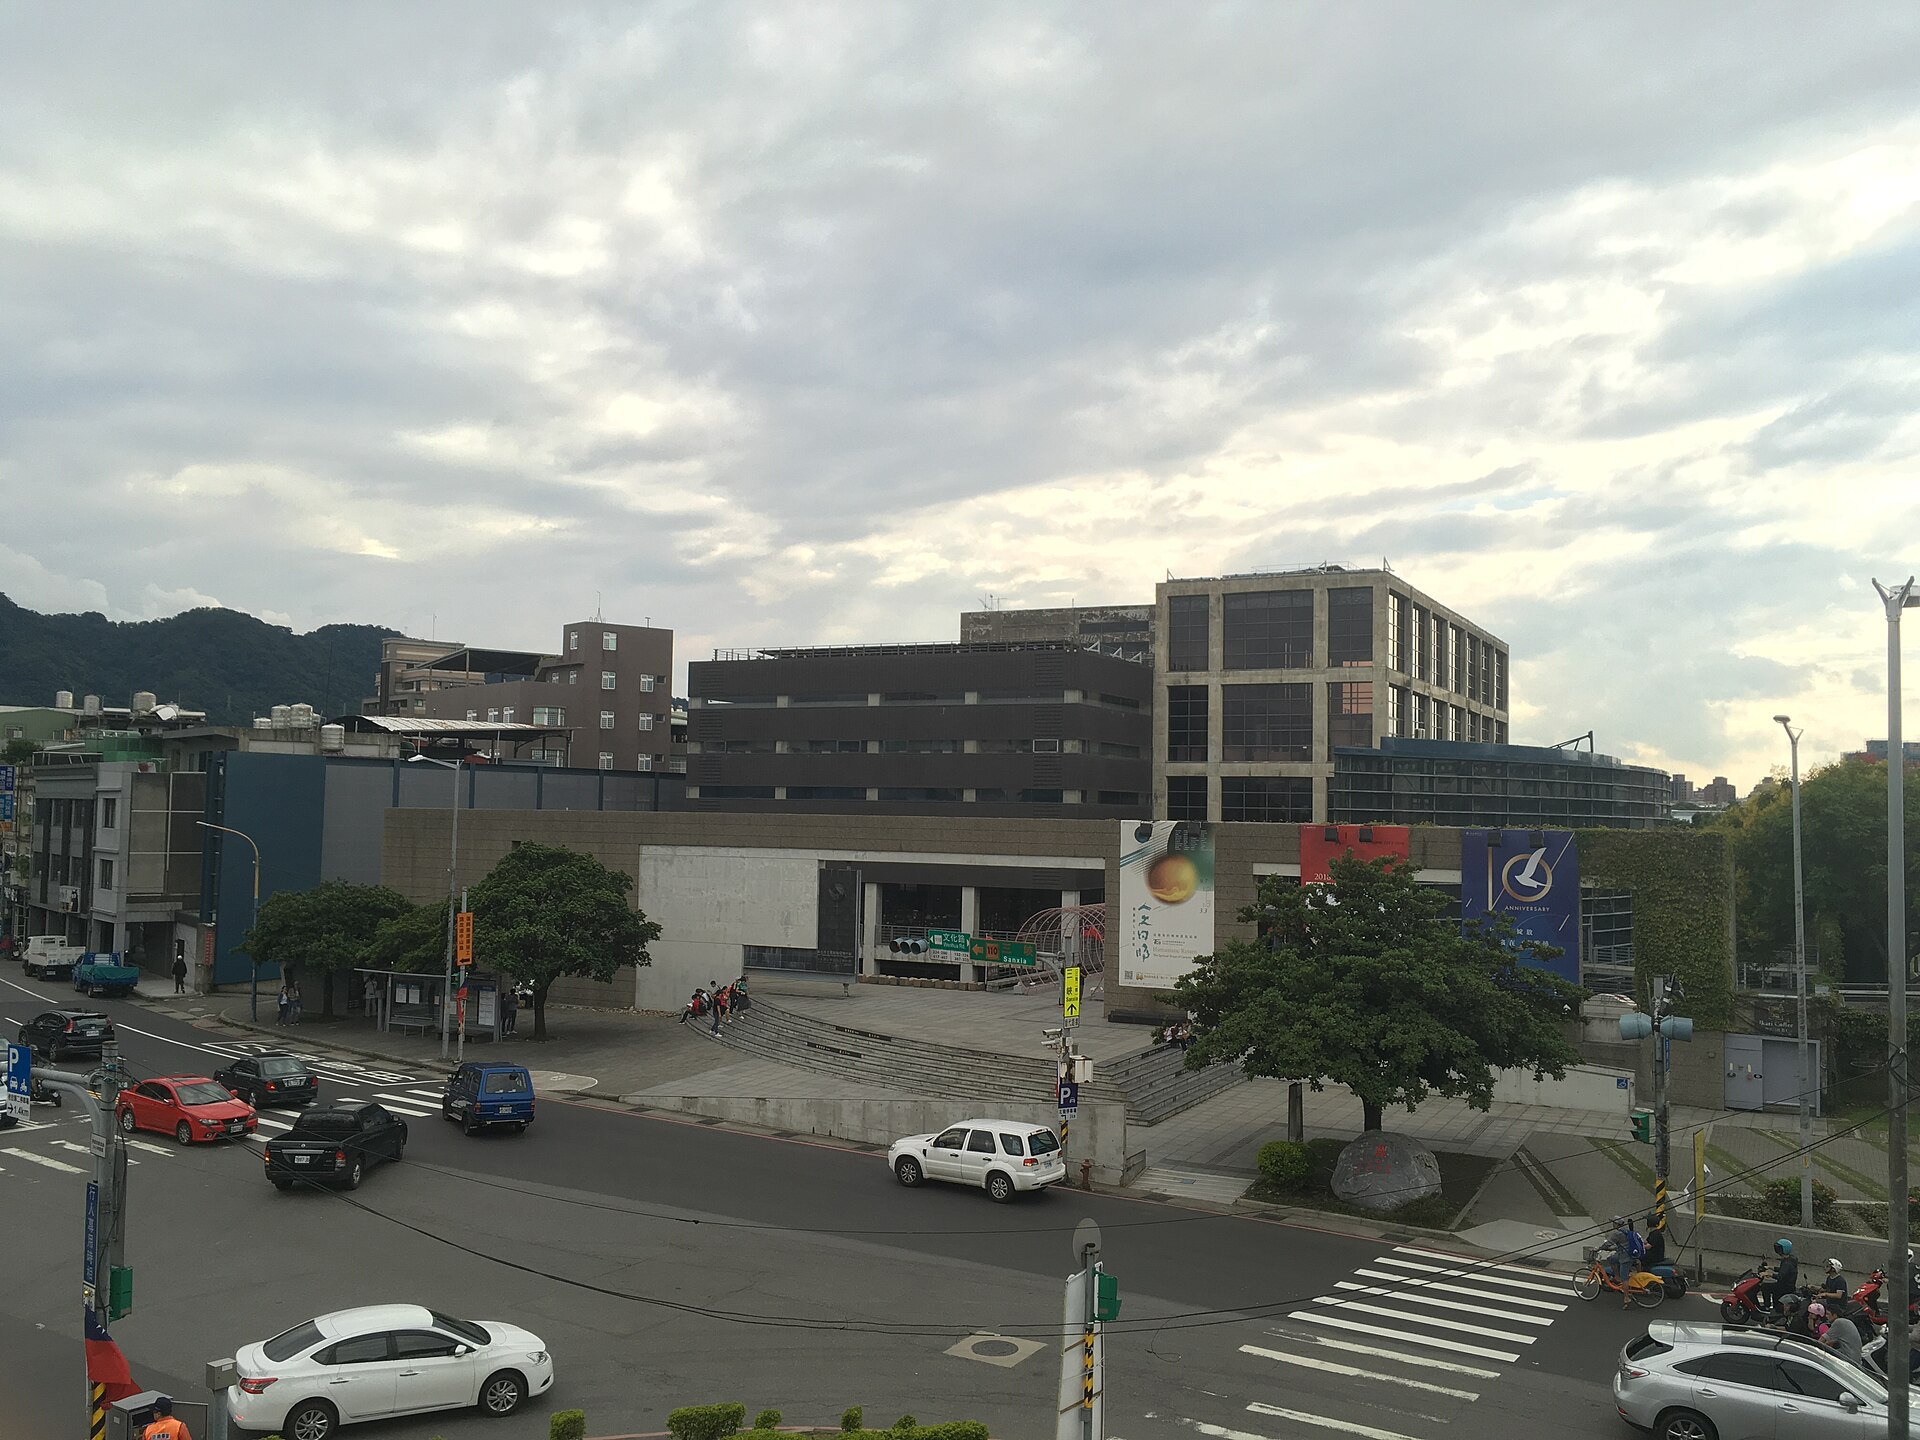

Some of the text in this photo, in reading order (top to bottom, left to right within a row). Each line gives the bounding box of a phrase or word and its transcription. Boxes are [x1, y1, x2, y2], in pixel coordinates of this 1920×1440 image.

[943, 933, 965, 944] 文化路
[987, 946, 998, 956] 110
[1003, 956, 1027, 964] Sanxia
[9, 1048, 19, 1072] P
[1060, 1087, 1071, 1105] P
